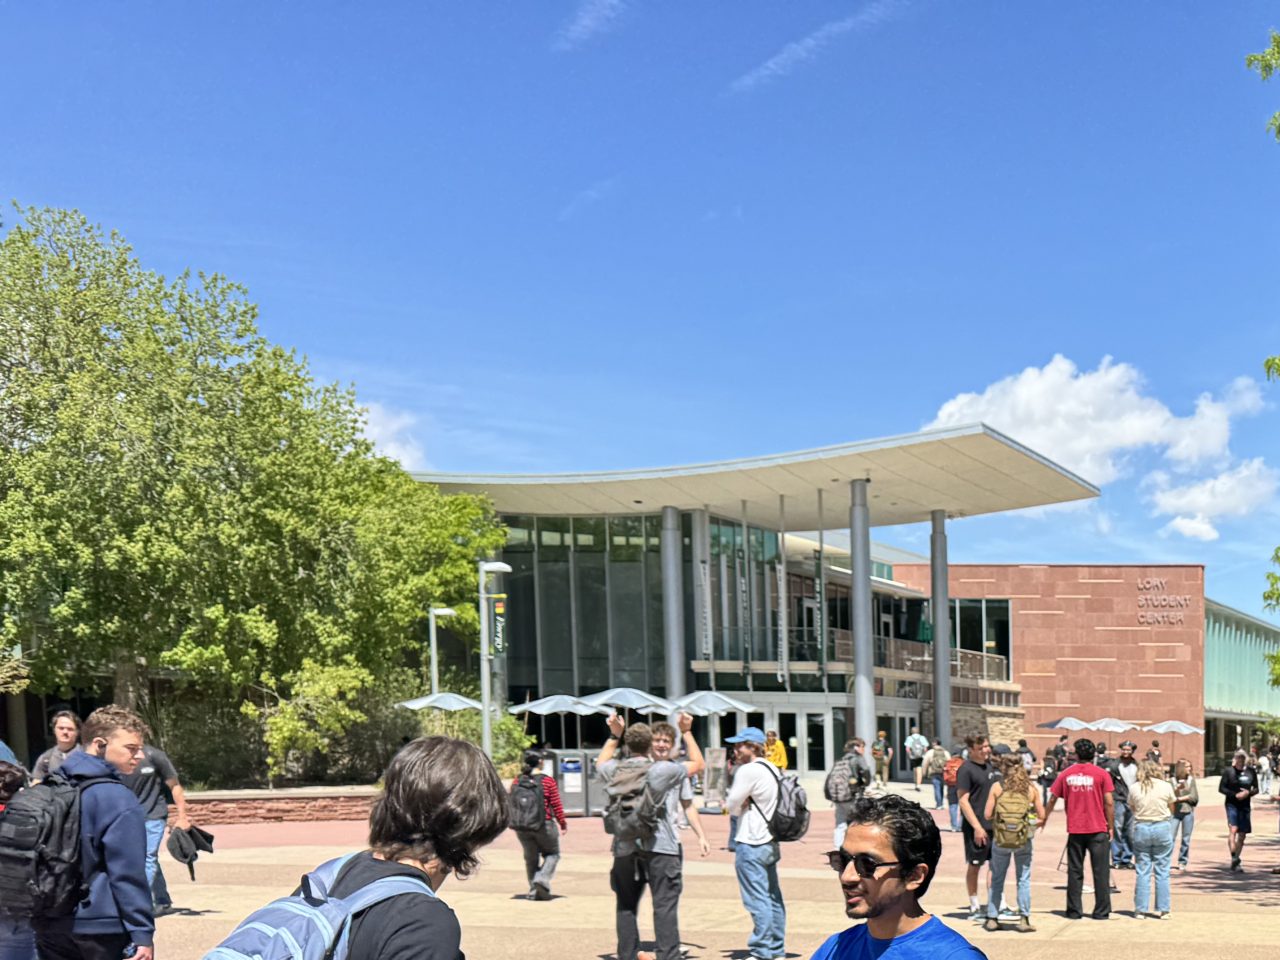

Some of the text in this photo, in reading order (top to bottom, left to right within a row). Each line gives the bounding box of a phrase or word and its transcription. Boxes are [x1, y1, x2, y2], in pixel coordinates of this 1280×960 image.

[1137, 578, 1168, 591] LORY
[1137, 595, 1192, 608] STUDENT
[1137, 611, 1184, 625] CENTER
